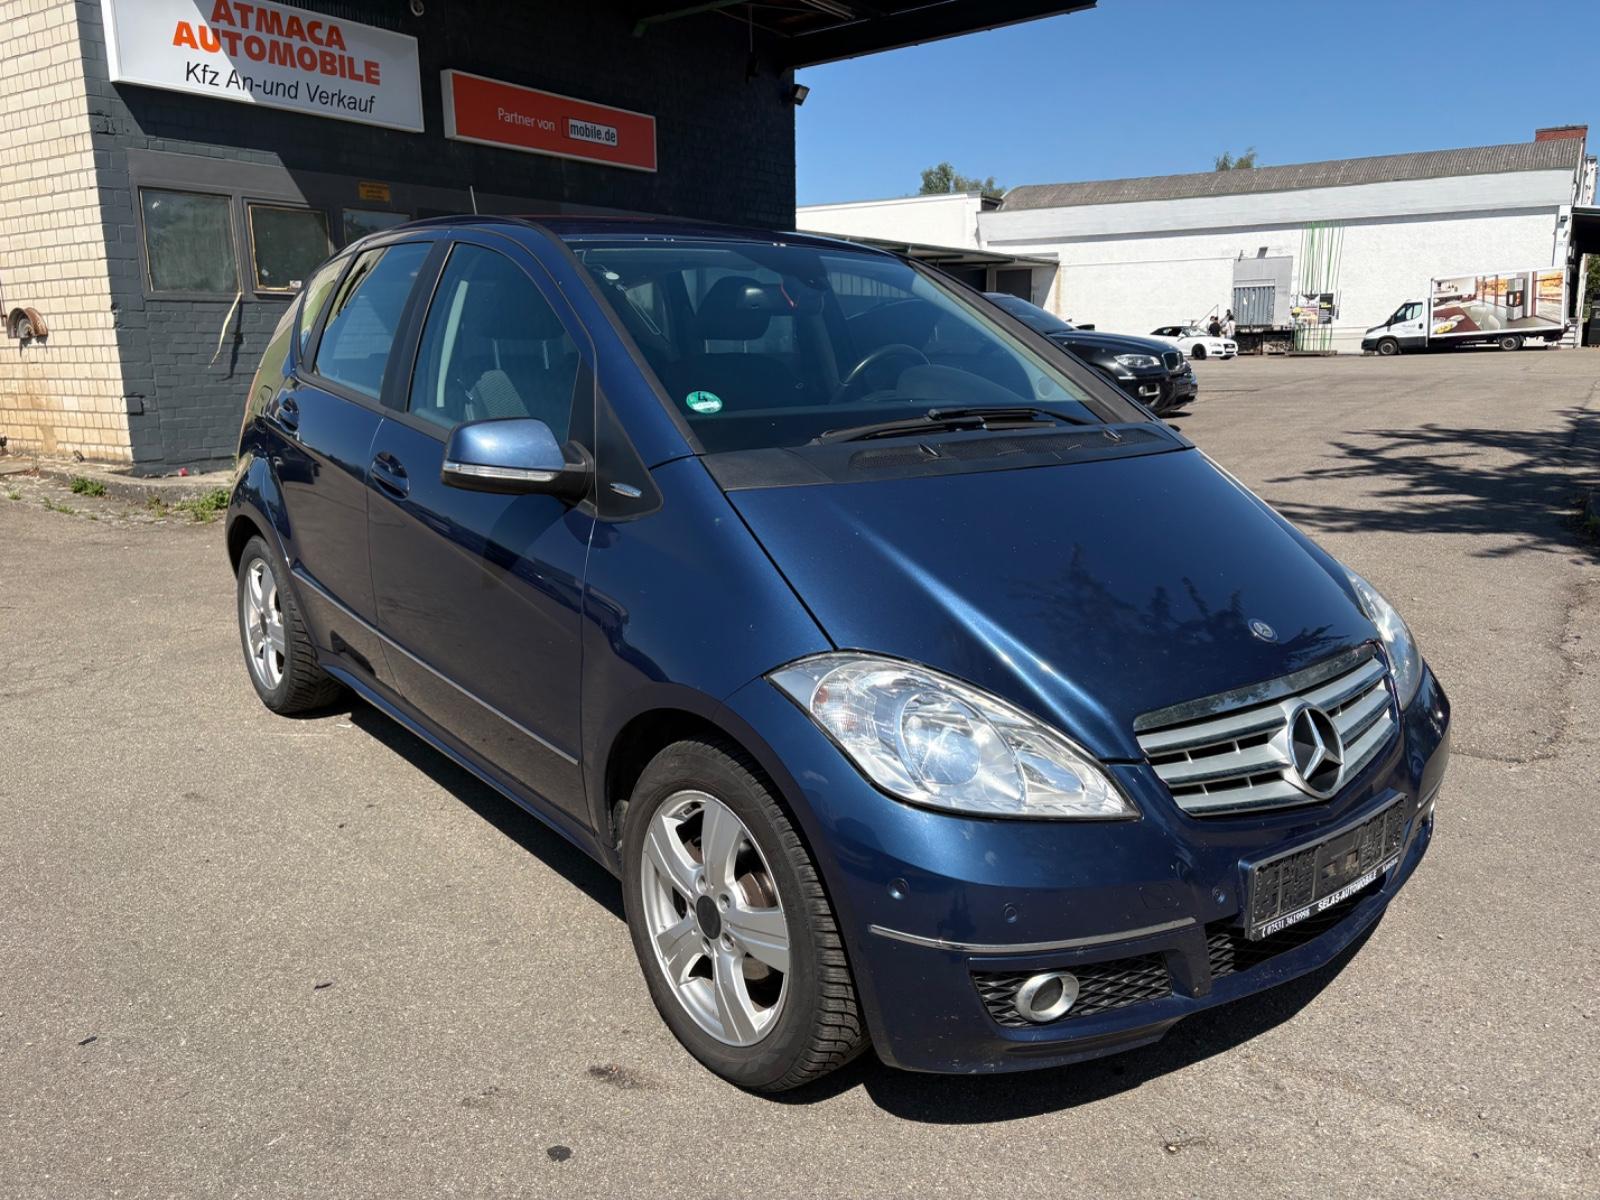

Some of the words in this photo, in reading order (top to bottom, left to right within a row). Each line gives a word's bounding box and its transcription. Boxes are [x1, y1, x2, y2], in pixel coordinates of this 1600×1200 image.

[210, 0, 346, 52] ATMACA
[172, 20, 381, 86] AUTOMOBILE
[185, 61, 220, 86] Kfz
[225, 69, 299, 100] An-und
[306, 82, 376, 114] Verkauf
[497, 107, 535, 128] Partner
[537, 118, 556, 132] von
[569, 122, 617, 144] mobile.de
